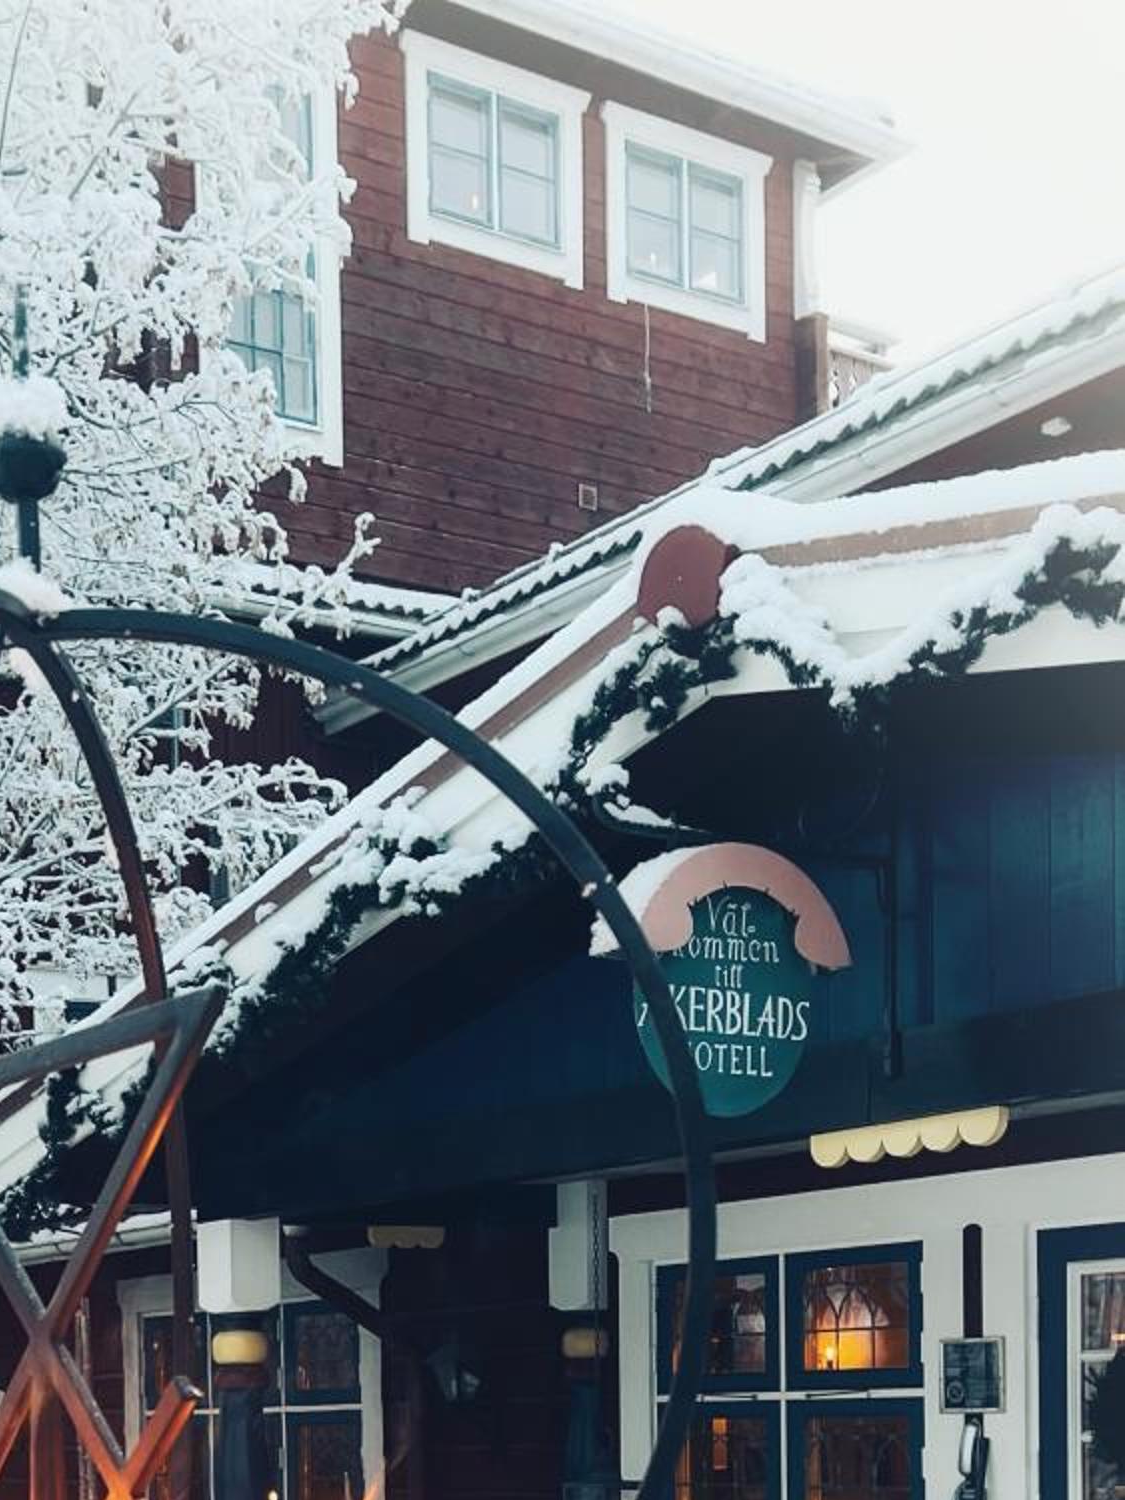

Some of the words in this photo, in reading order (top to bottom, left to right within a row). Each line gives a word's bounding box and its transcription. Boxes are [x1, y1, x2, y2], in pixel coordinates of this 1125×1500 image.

[673, 936, 779, 962] ommen
[715, 964, 742, 988] till
[687, 1041, 774, 1077] OTELL
